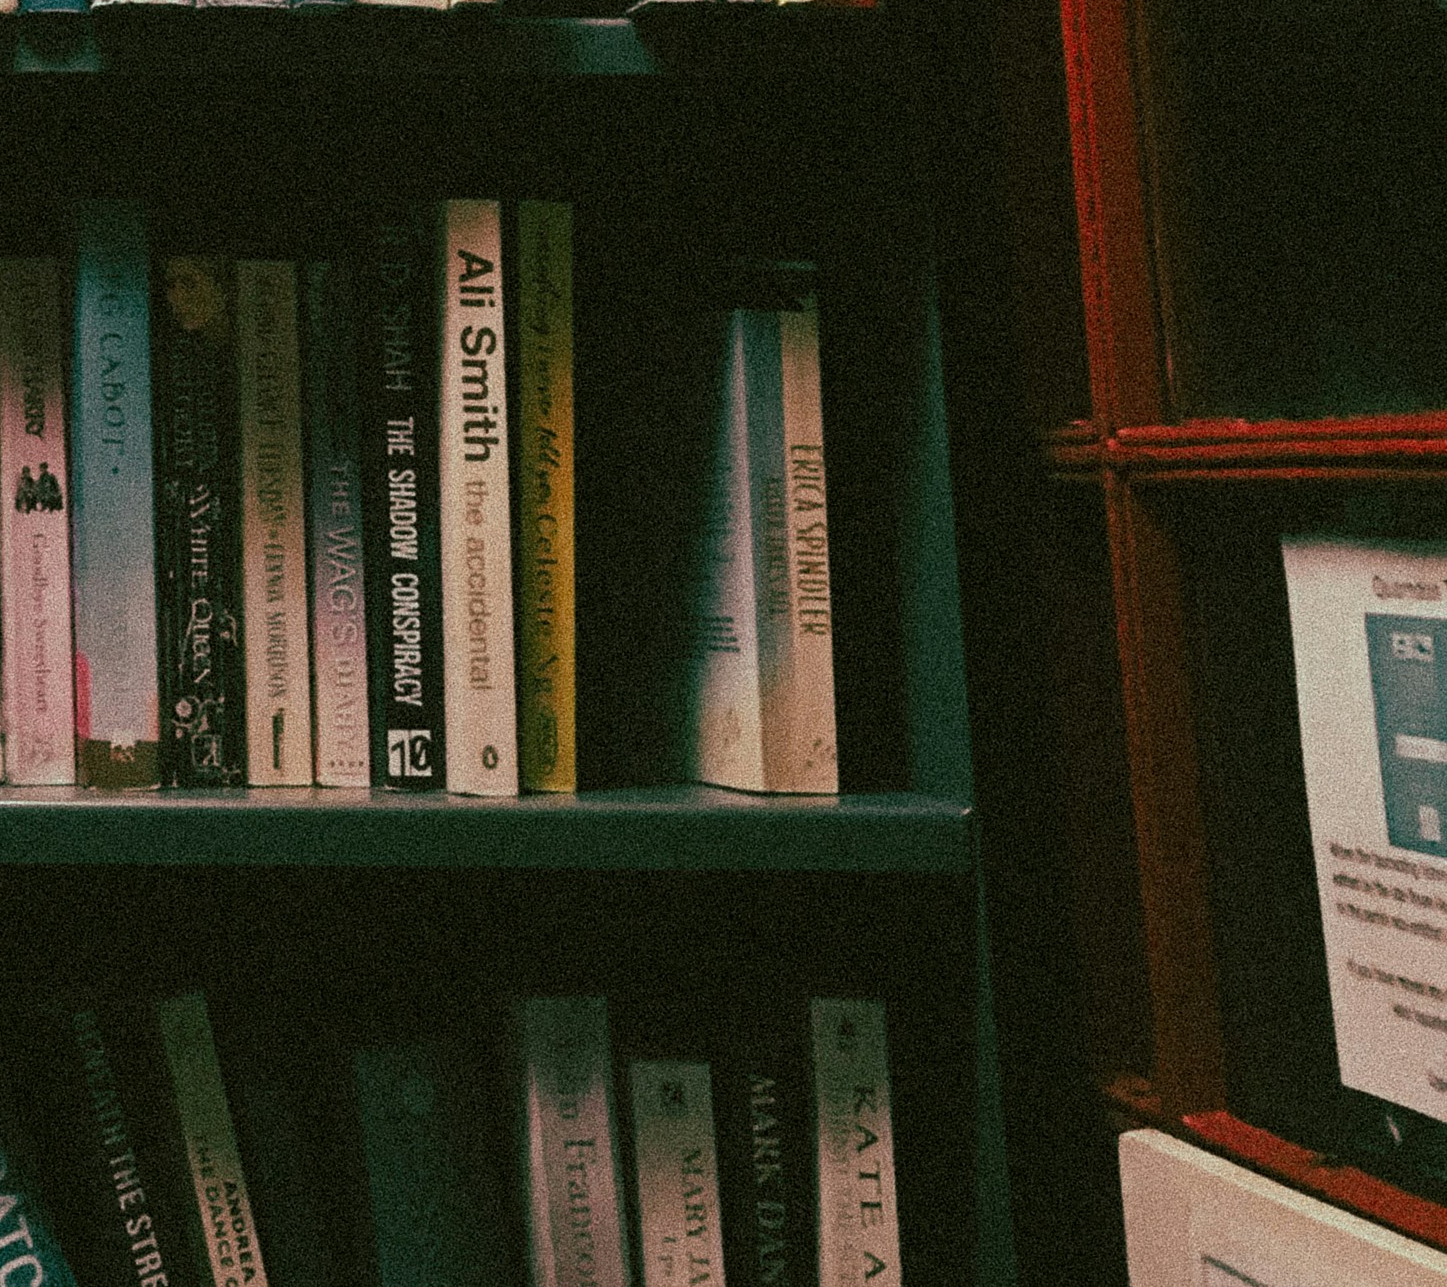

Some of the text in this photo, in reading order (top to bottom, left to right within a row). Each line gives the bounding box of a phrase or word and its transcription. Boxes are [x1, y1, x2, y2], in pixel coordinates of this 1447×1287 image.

[100, 332, 126, 444] CABOT
[455, 249, 499, 464] Ali Smith
[384, 415, 414, 458] THE
[188, 484, 213, 586] WHITE
[326, 465, 359, 645] THE WAG'S
[387, 468, 417, 561] SHADOW
[790, 443, 829, 637] ERICA SPINDLER
[28, 532, 50, 614] Goodbye
[464, 478, 493, 692] the accidental
[535, 511, 559, 639] Celeste
[390, 572, 423, 709] CONSPIRACY
[109, 1151, 147, 1212] THE
[681, 1148, 708, 1238] MARY
[853, 1086, 883, 1227] KATE
[203, 1185, 231, 1266] DANCE
[223, 1181, 258, 1285] ANDREA
